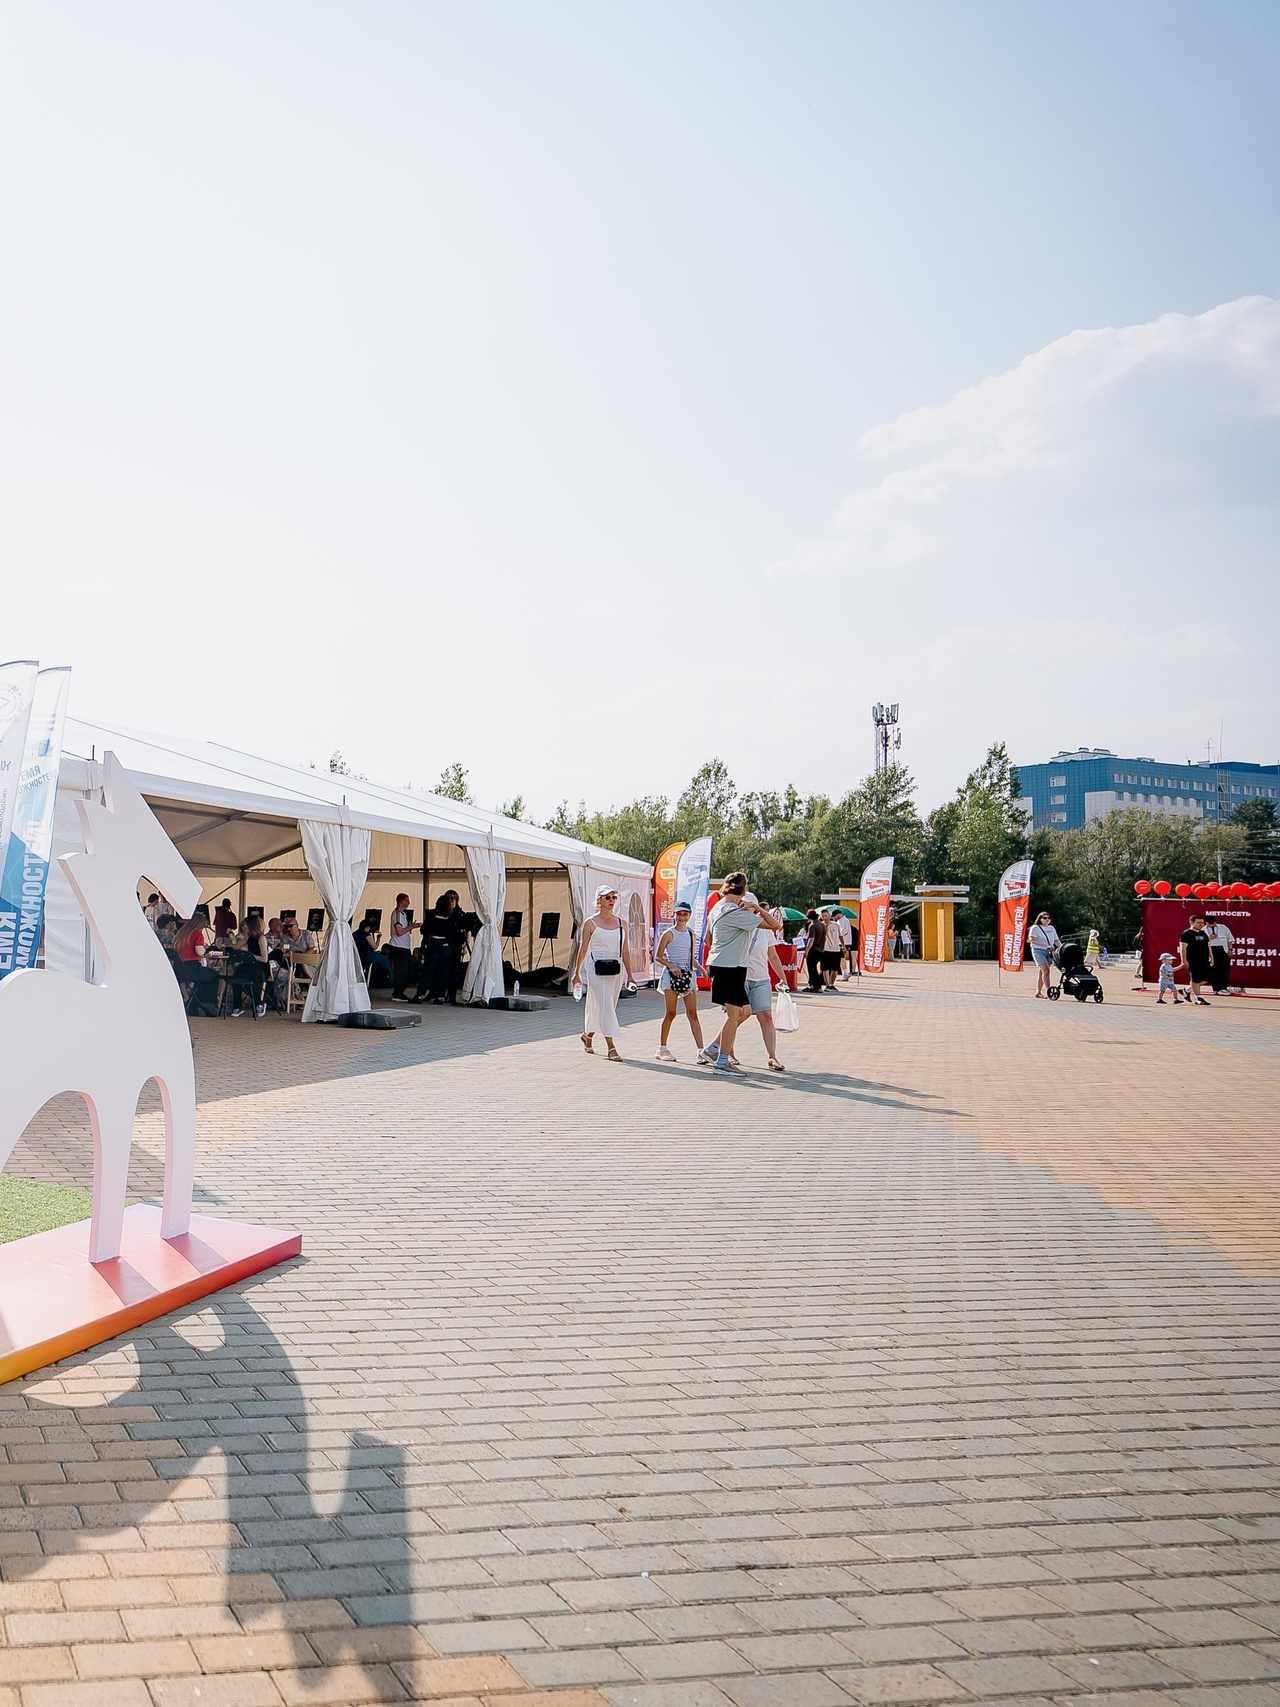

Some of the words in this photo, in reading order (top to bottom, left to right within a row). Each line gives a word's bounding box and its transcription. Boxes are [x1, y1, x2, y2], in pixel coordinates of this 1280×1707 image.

[21, 764, 41, 782] ЕМЯ
[864, 934, 876, 967] ВРЕМЯ
[873, 905, 887, 968] ВОЗМОЖНОСТЕЙ!
[1003, 933, 1014, 966] ВРЕМЯ
[1011, 906, 1025, 967] ВОЗМОЖНОСТЕЙ!
